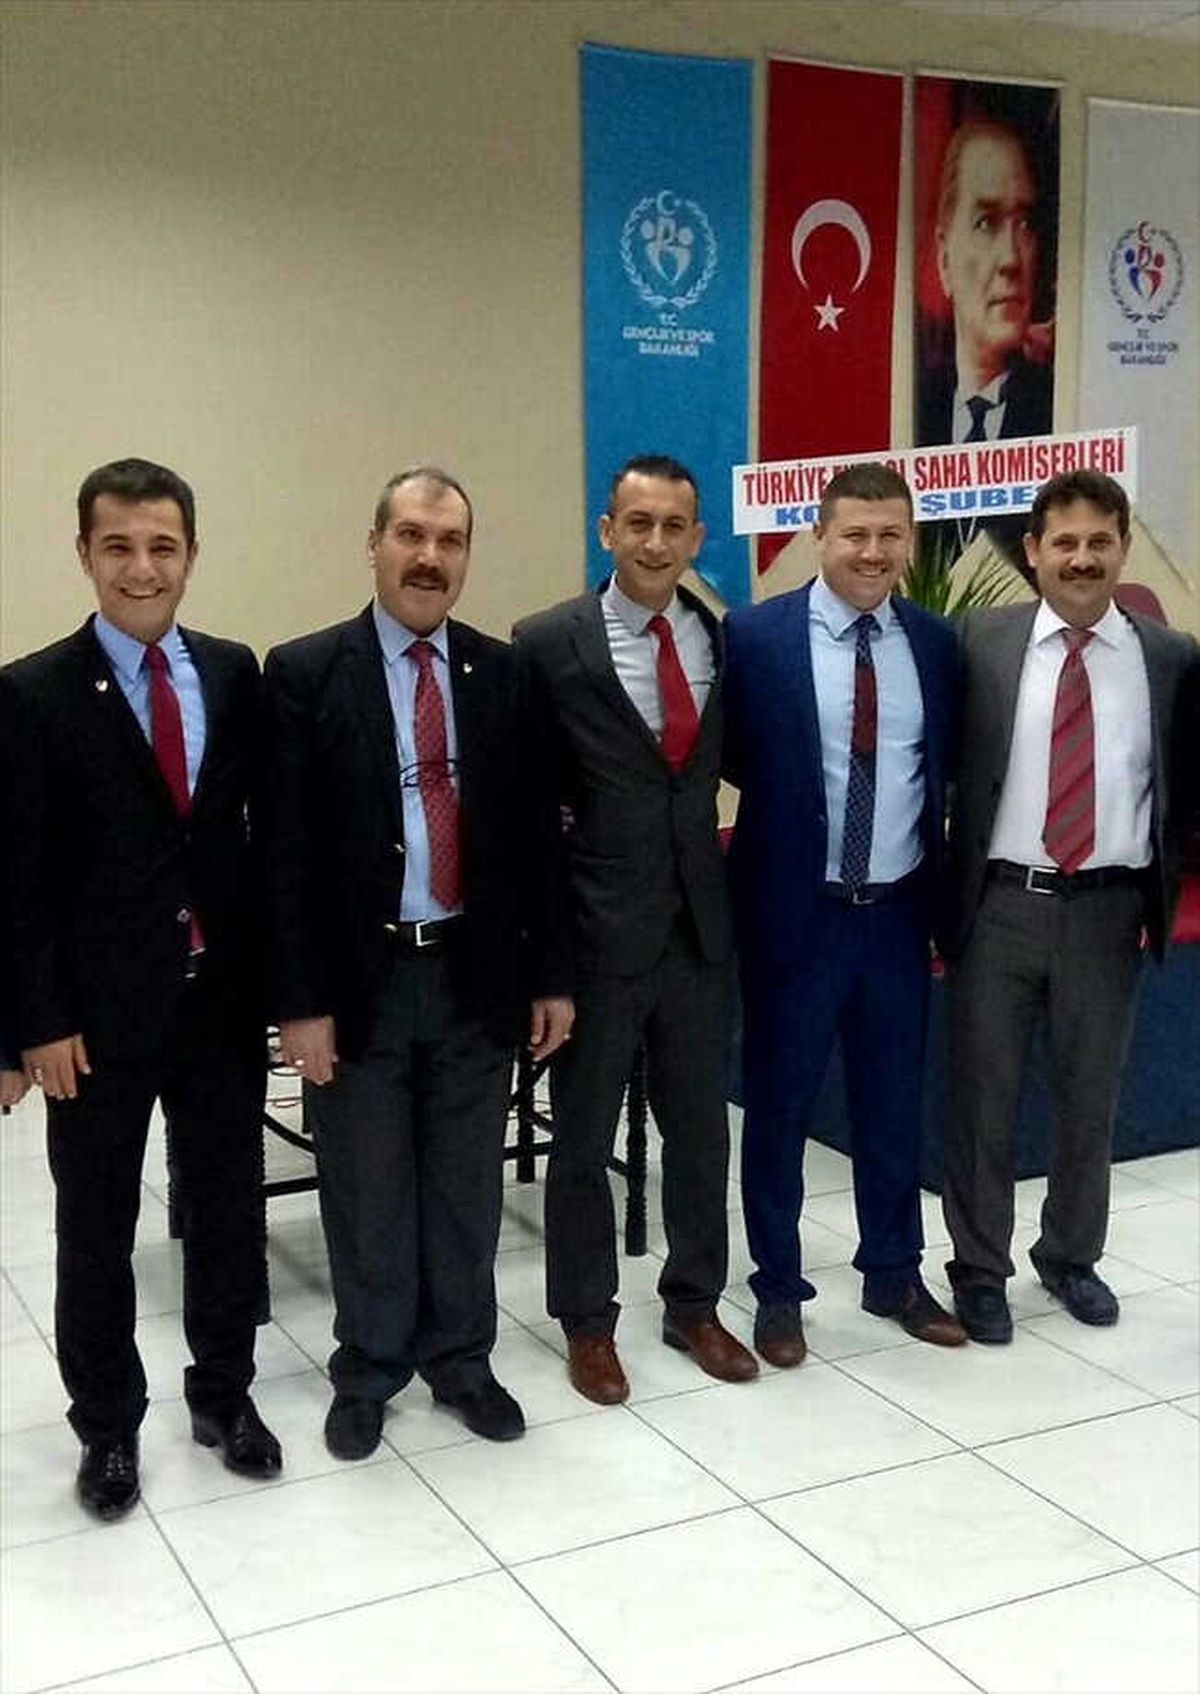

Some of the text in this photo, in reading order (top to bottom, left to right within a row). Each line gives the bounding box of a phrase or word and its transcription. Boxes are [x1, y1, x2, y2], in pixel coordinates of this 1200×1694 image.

[743, 463, 827, 506] TÜRKİYE
[914, 452, 971, 491] SAHA
[976, 431, 1124, 485] KOMİSERLERİ
[920, 484, 1040, 515] ŞUBE
